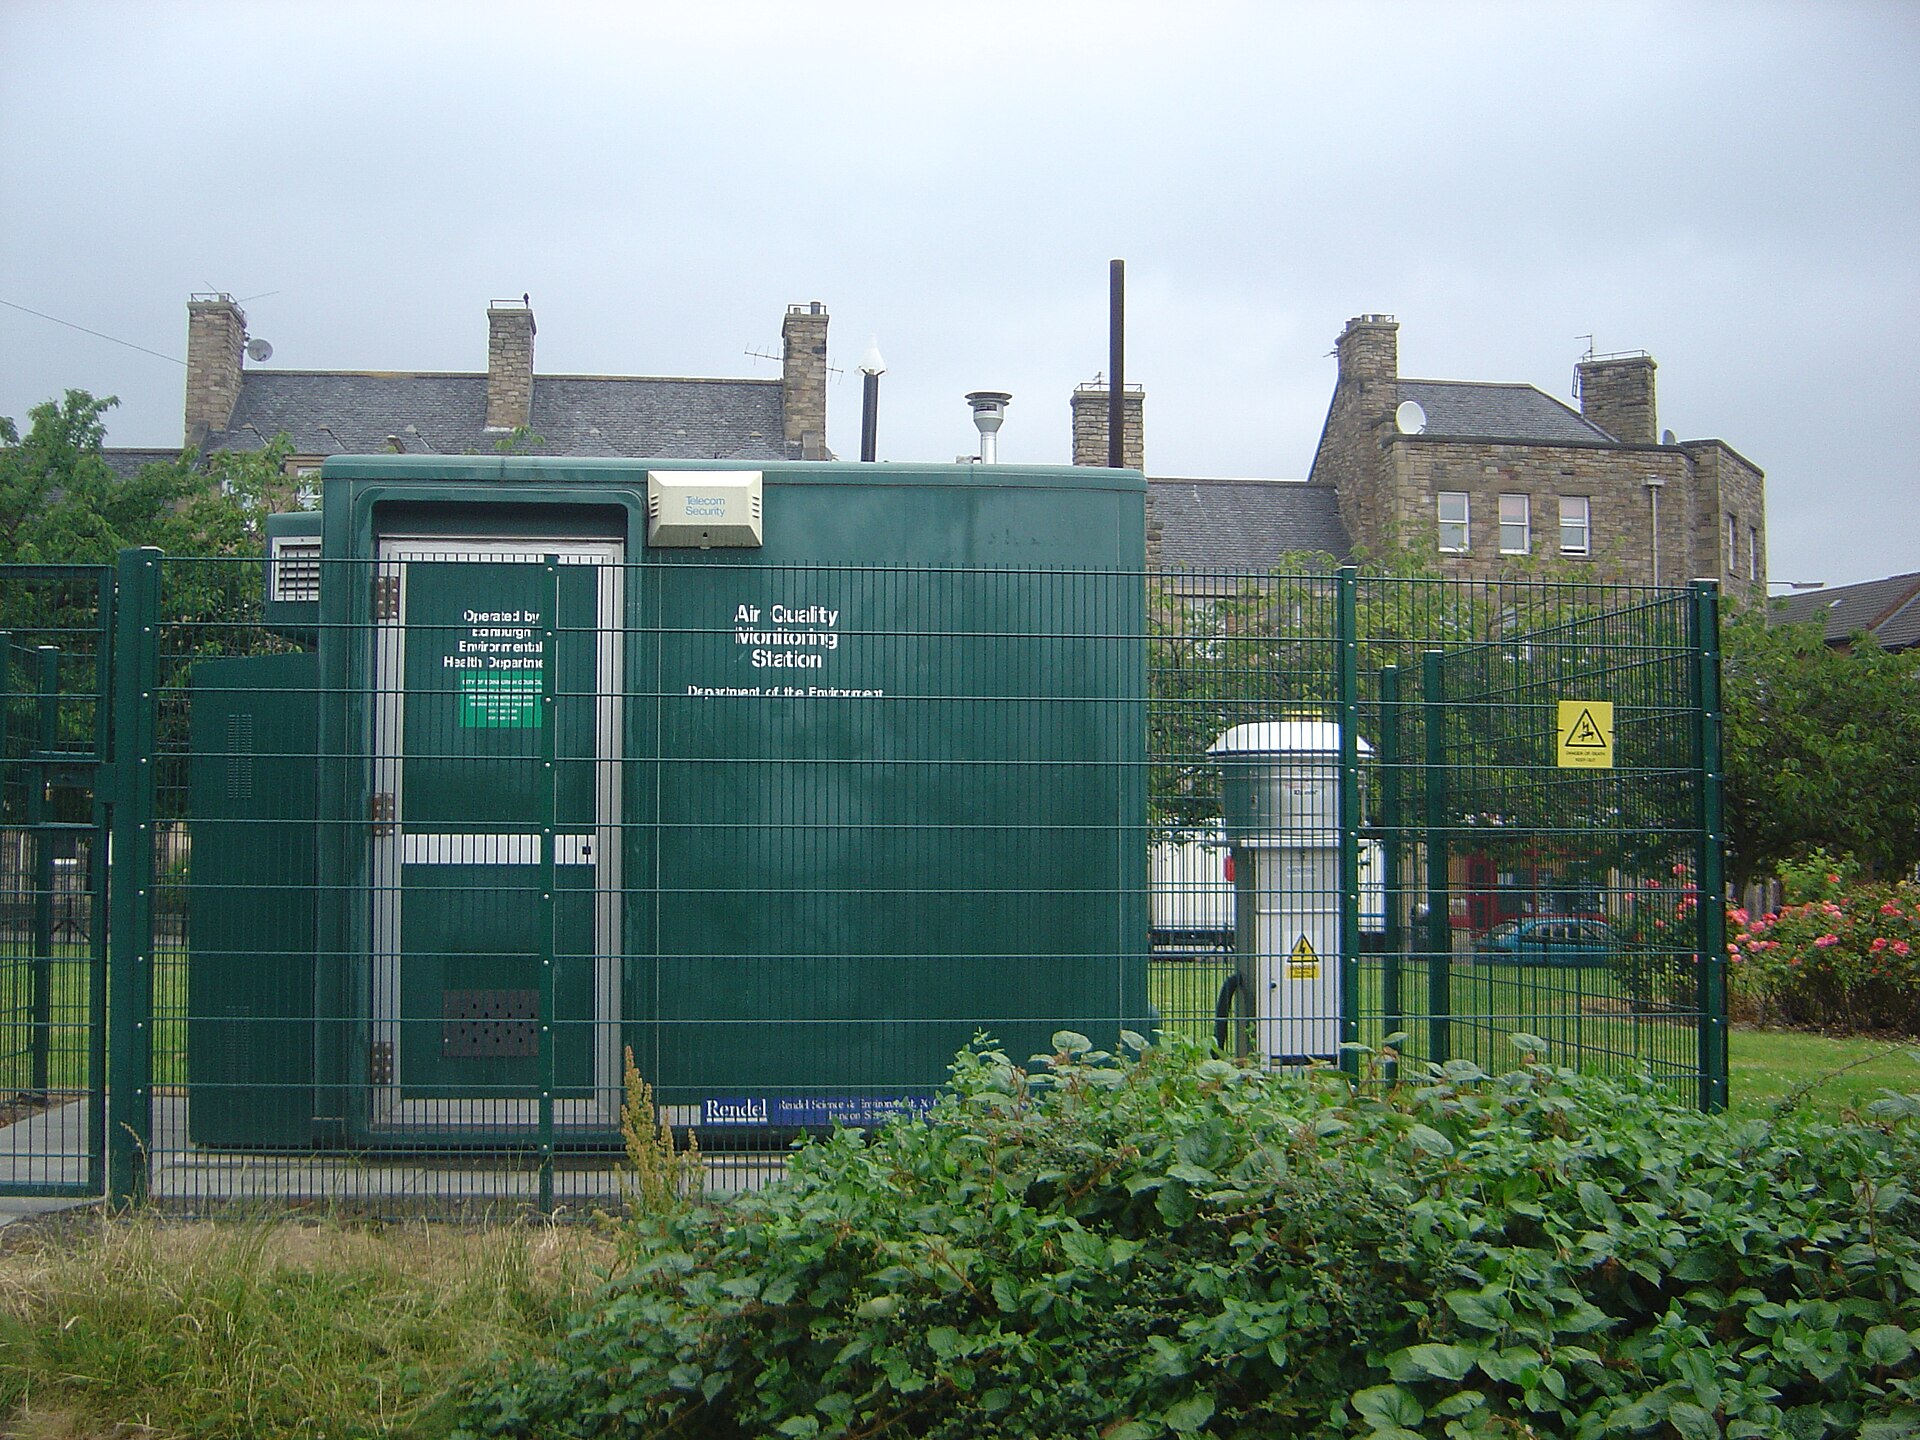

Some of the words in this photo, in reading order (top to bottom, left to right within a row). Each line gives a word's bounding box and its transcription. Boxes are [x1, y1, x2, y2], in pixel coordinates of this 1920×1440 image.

[685, 495, 725, 506] Telecom
[685, 506, 726, 517] Security
[463, 609, 520, 624] Operated
[524, 609, 540, 625] by
[734, 604, 761, 623] Air
[769, 604, 839, 627] Quality
[735, 626, 839, 649] Monitoring
[459, 640, 543, 653] Environmental
[443, 656, 482, 668] Health
[751, 648, 823, 668] Station
[687, 685, 760, 700] Department
[765, 686, 779, 697] of
[783, 686, 804, 697] the
[706, 1098, 767, 1117] Rendel
